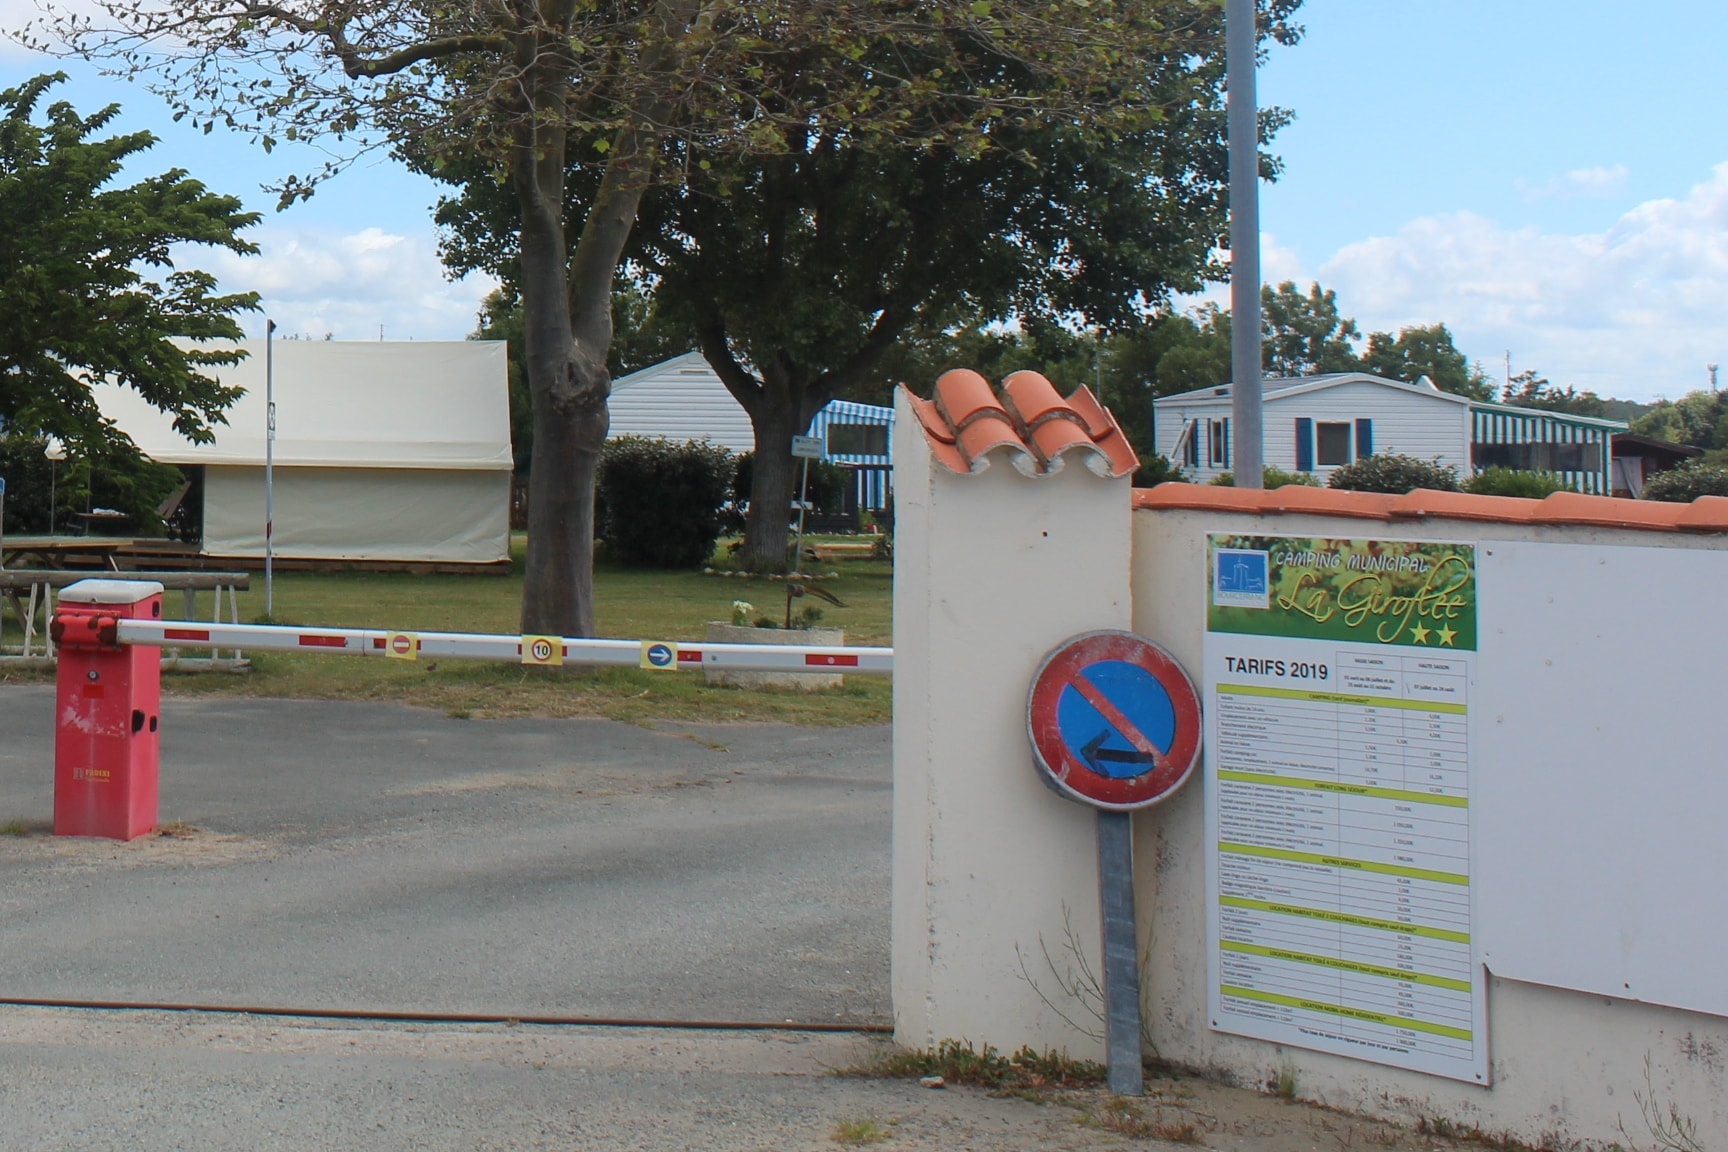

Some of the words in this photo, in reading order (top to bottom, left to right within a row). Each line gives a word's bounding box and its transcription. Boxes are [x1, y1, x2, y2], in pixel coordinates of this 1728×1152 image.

[1276, 551, 1340, 568] CAMPING
[1347, 554, 1428, 573] MUNICIPAL
[1278, 573, 1335, 623] La
[536, 645, 548, 655] 10
[1225, 657, 1285, 676] TARIFS
[1290, 662, 1328, 680] 2019
